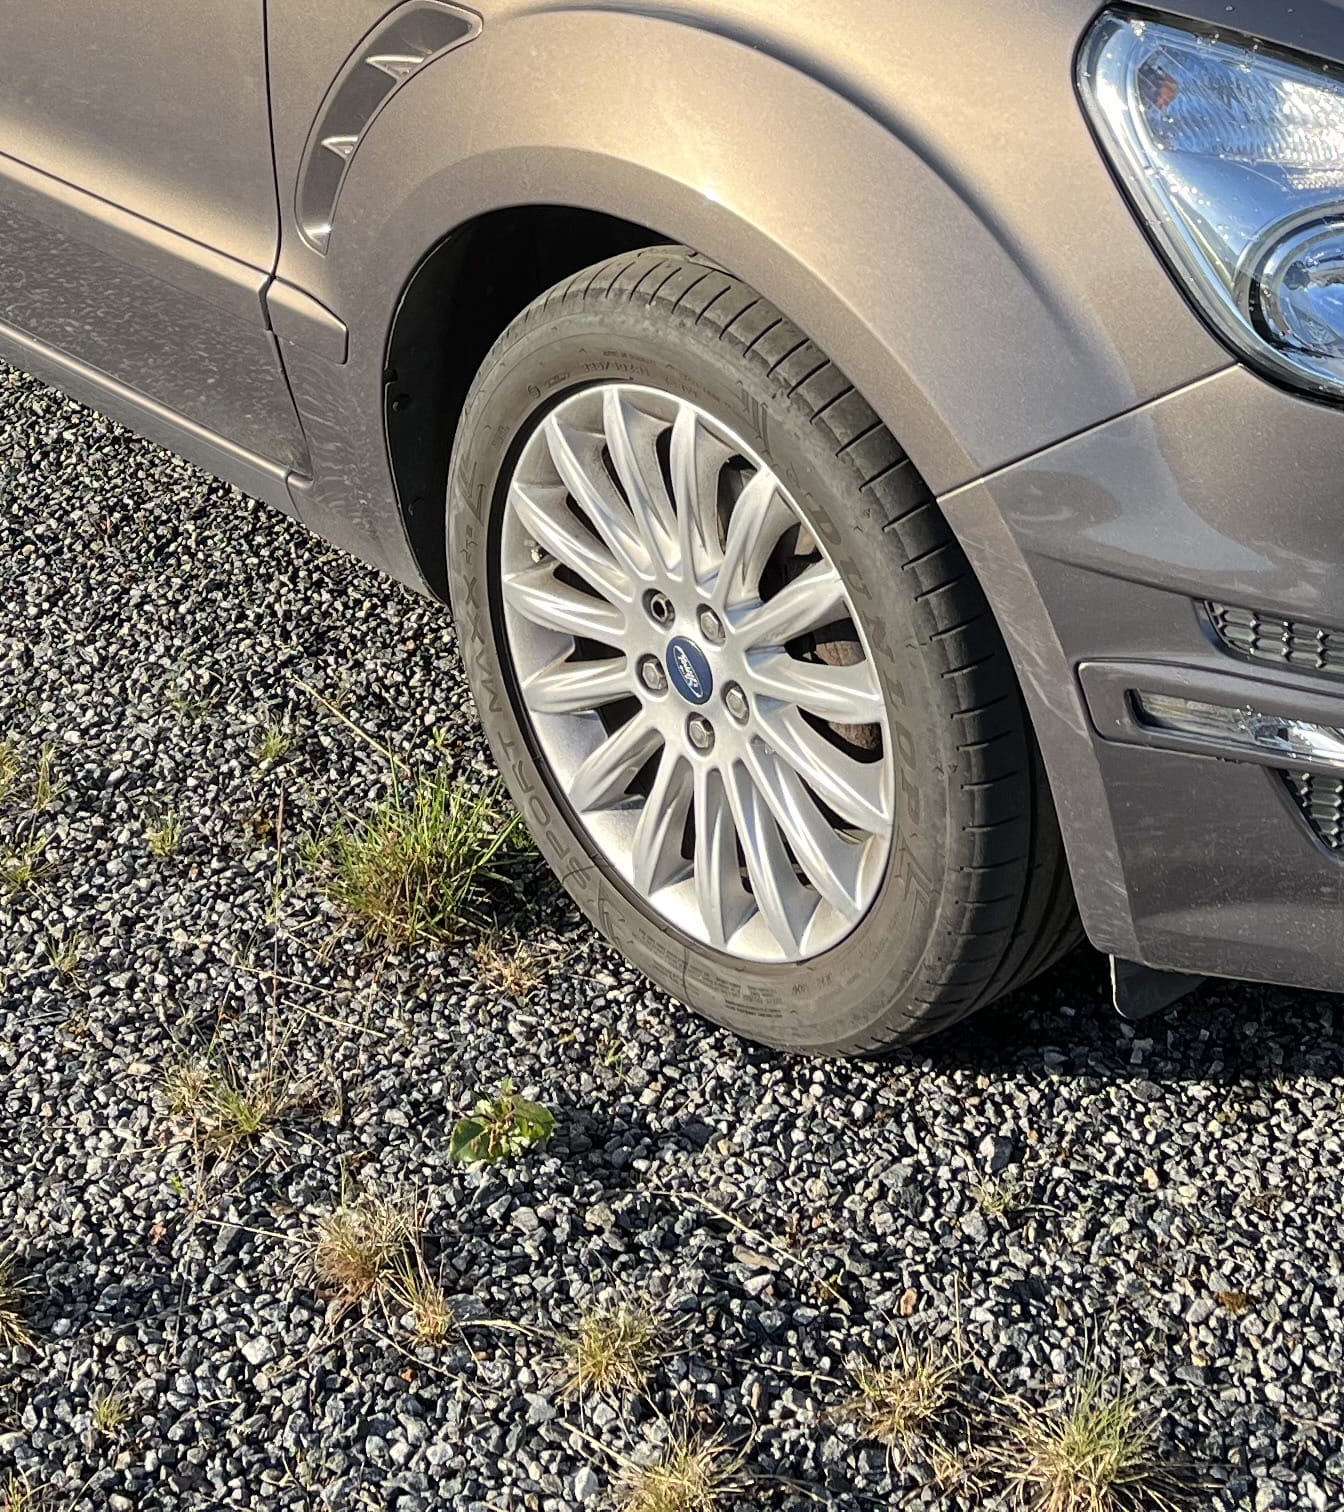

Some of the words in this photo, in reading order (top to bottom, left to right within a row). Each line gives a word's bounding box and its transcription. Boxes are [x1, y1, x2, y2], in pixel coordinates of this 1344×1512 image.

[463, 574, 503, 714] MAXX
[803, 492, 921, 827] DUNLOP
[496, 729, 591, 890] SPORT
